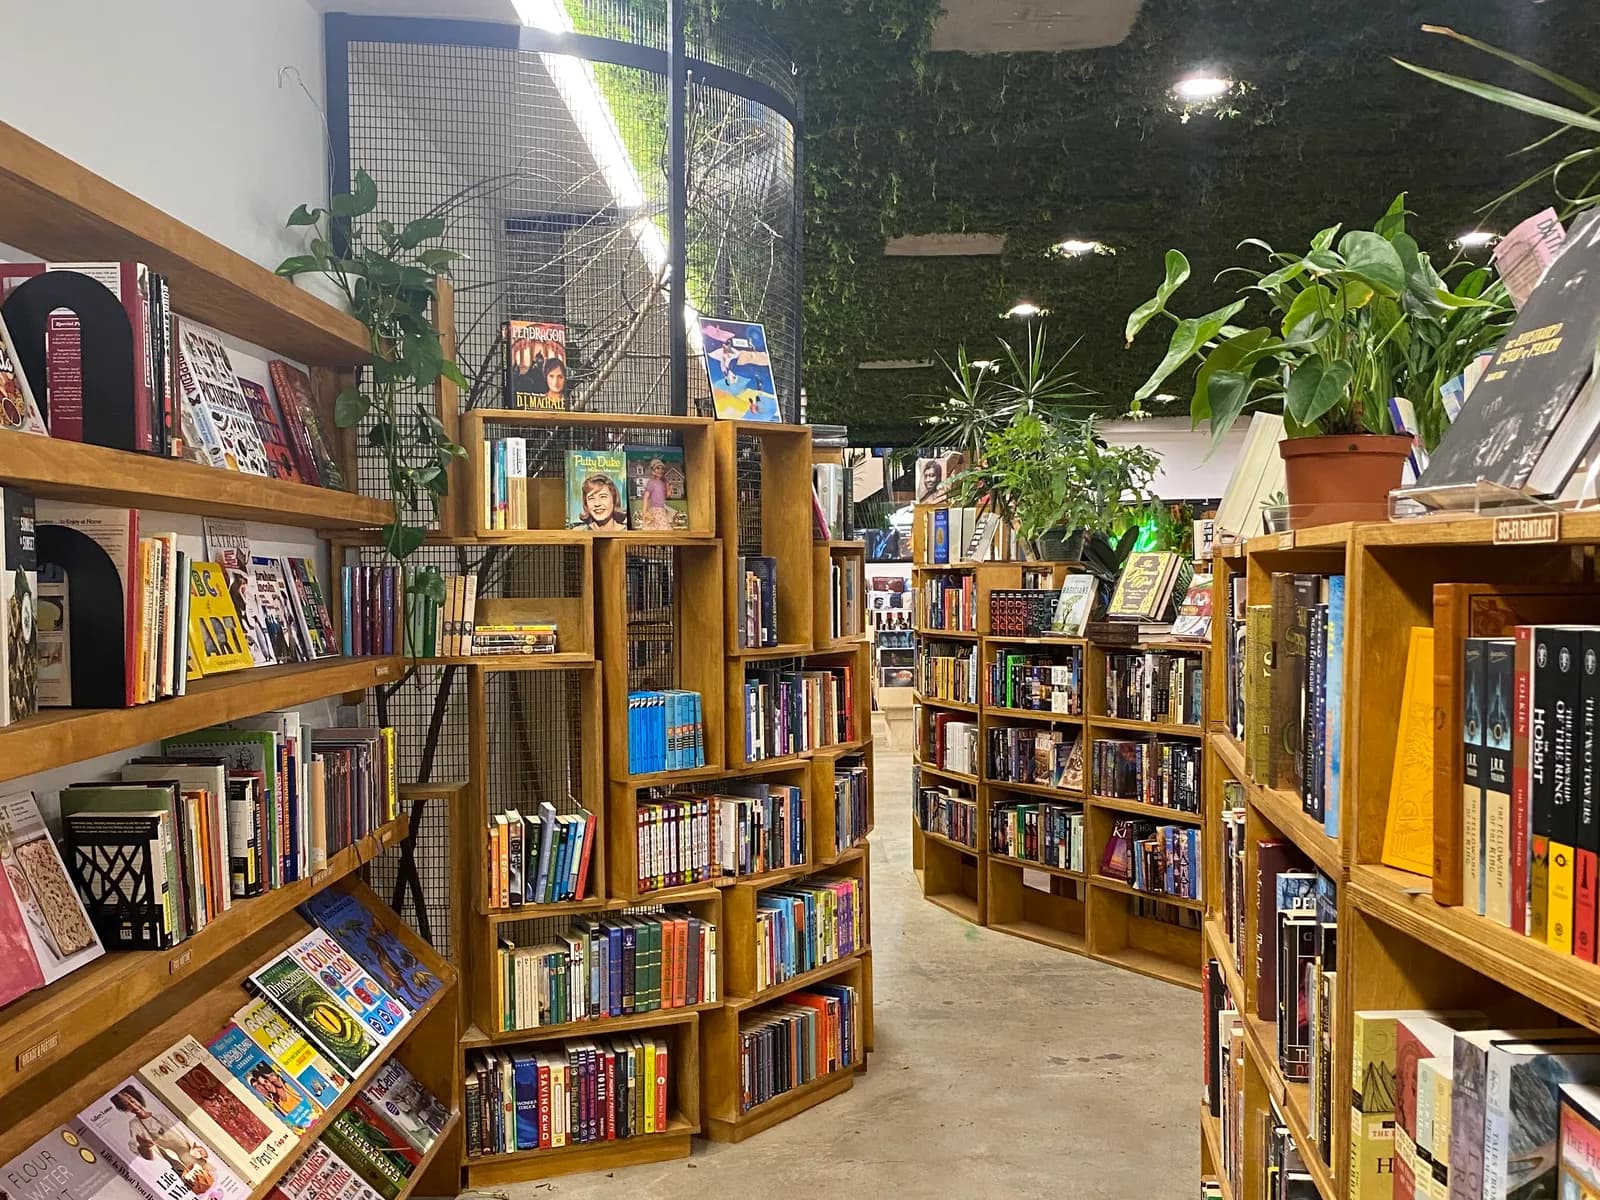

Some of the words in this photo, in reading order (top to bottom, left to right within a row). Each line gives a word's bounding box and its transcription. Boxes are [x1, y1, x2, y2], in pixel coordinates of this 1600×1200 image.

[512, 326, 565, 345] PENDRAGON
[574, 454, 597, 468] Patty
[598, 455, 620, 468] Duke
[208, 525, 248, 550] EXTREME
[1499, 520, 1519, 539] SCI-FI
[1520, 518, 1552, 539] FANTASY
[192, 569, 218, 598] BC
[200, 616, 242, 657] ART
[1518, 676, 1526, 734] TOLKIEN
[1556, 700, 1566, 724] OF
[1584, 696, 1594, 726] THE
[1534, 708, 1546, 784] HOBBIT
[1555, 726, 1565, 760] THE
[1584, 729, 1594, 764] TWO
[1564, 730, 1572, 802] FELLOWSHIP
[1554, 763, 1564, 806] RING
[1582, 765, 1593, 824] TOWERS
[1490, 815, 1496, 826] OF
[301, 938, 341, 973] CODING
[327, 953, 357, 980] BOOK
[266, 967, 306, 998] Dinosaurs
[540, 1074, 548, 1114] SAVING
[598, 1073, 605, 1082] TO
[1492, 1132, 1500, 1166] TALES
[1566, 1126, 1584, 1153] THE
[8, 1150, 57, 1189] FLOUR
[100, 1149, 115, 1163] Life
[112, 1161, 121, 1169] Is
[118, 1166, 137, 1184] What
[134, 1182, 148, 1196] You
[156, 1169, 178, 1191] Life
[288, 1149, 329, 1192] TIMELINES
